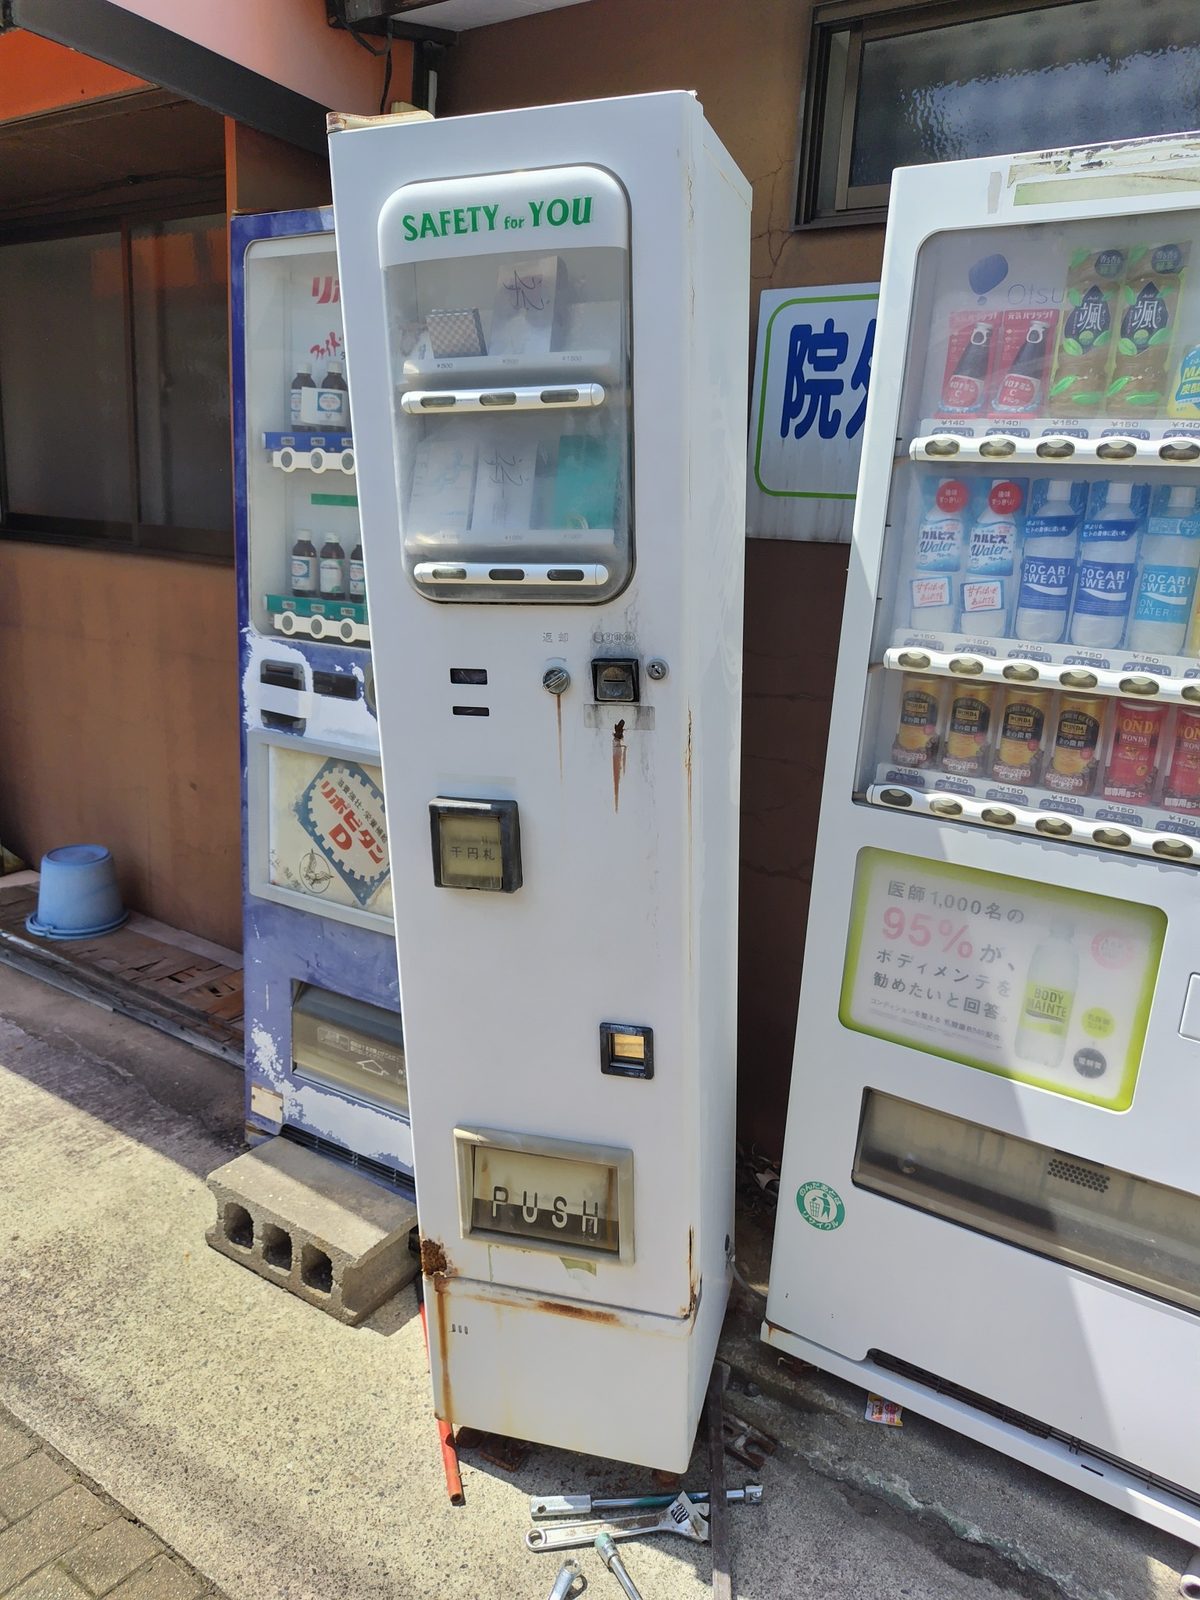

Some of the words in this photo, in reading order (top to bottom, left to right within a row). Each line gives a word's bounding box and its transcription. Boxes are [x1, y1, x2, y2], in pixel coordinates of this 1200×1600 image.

[402, 204, 499, 241] SAFETY
[504, 216, 525, 230] for
[528, 197, 593, 227] YOU
[1077, 303, 1102, 331] 颯
[1132, 301, 1157, 329] 颯
[1009, 389, 1016, 397] C
[994, 419, 1018, 427] ¥140
[922, 530, 955, 541] カルピス
[973, 533, 1008, 544] カルピス
[920, 540, 956, 553] Water
[971, 544, 1008, 557] Water
[1024, 564, 1071, 575] POCARI
[1082, 568, 1130, 580] POCARI
[1023, 574, 1066, 584] SWEAT
[1080, 579, 1125, 590] SWEAT
[1142, 573, 1190, 585] POCARI
[1141, 583, 1185, 594] SWEAT
[965, 638, 990, 646] ¥150
[1017, 643, 1043, 652] ¥150
[1076, 650, 1103, 659] ¥150
[1132, 654, 1160, 664] ¥150
[1062, 722, 1085, 735] WONDA
[1122, 734, 1148, 745] WONDA
[897, 768, 919, 776] ¥150
[945, 776, 968, 785] ¥150
[999, 786, 1023, 795] ¥150
[1051, 795, 1077, 804] ¥150
[1108, 805, 1134, 814] ¥150
[320, 780, 384, 864] リポビタン
[1168, 815, 1196, 826] ¥150
[328, 823, 353, 851] D
[450, 846, 495, 861] 千円札
[888, 880, 1025, 924] 医師1,000名の
[876, 949, 1011, 998] ボディメンテを
[873, 971, 1008, 1023] 勧めたいと回答。
[1034, 988, 1064, 1005] BODY
[492, 1186, 598, 1234] PUSH
[803, 1211, 839, 1230] リサイクル
